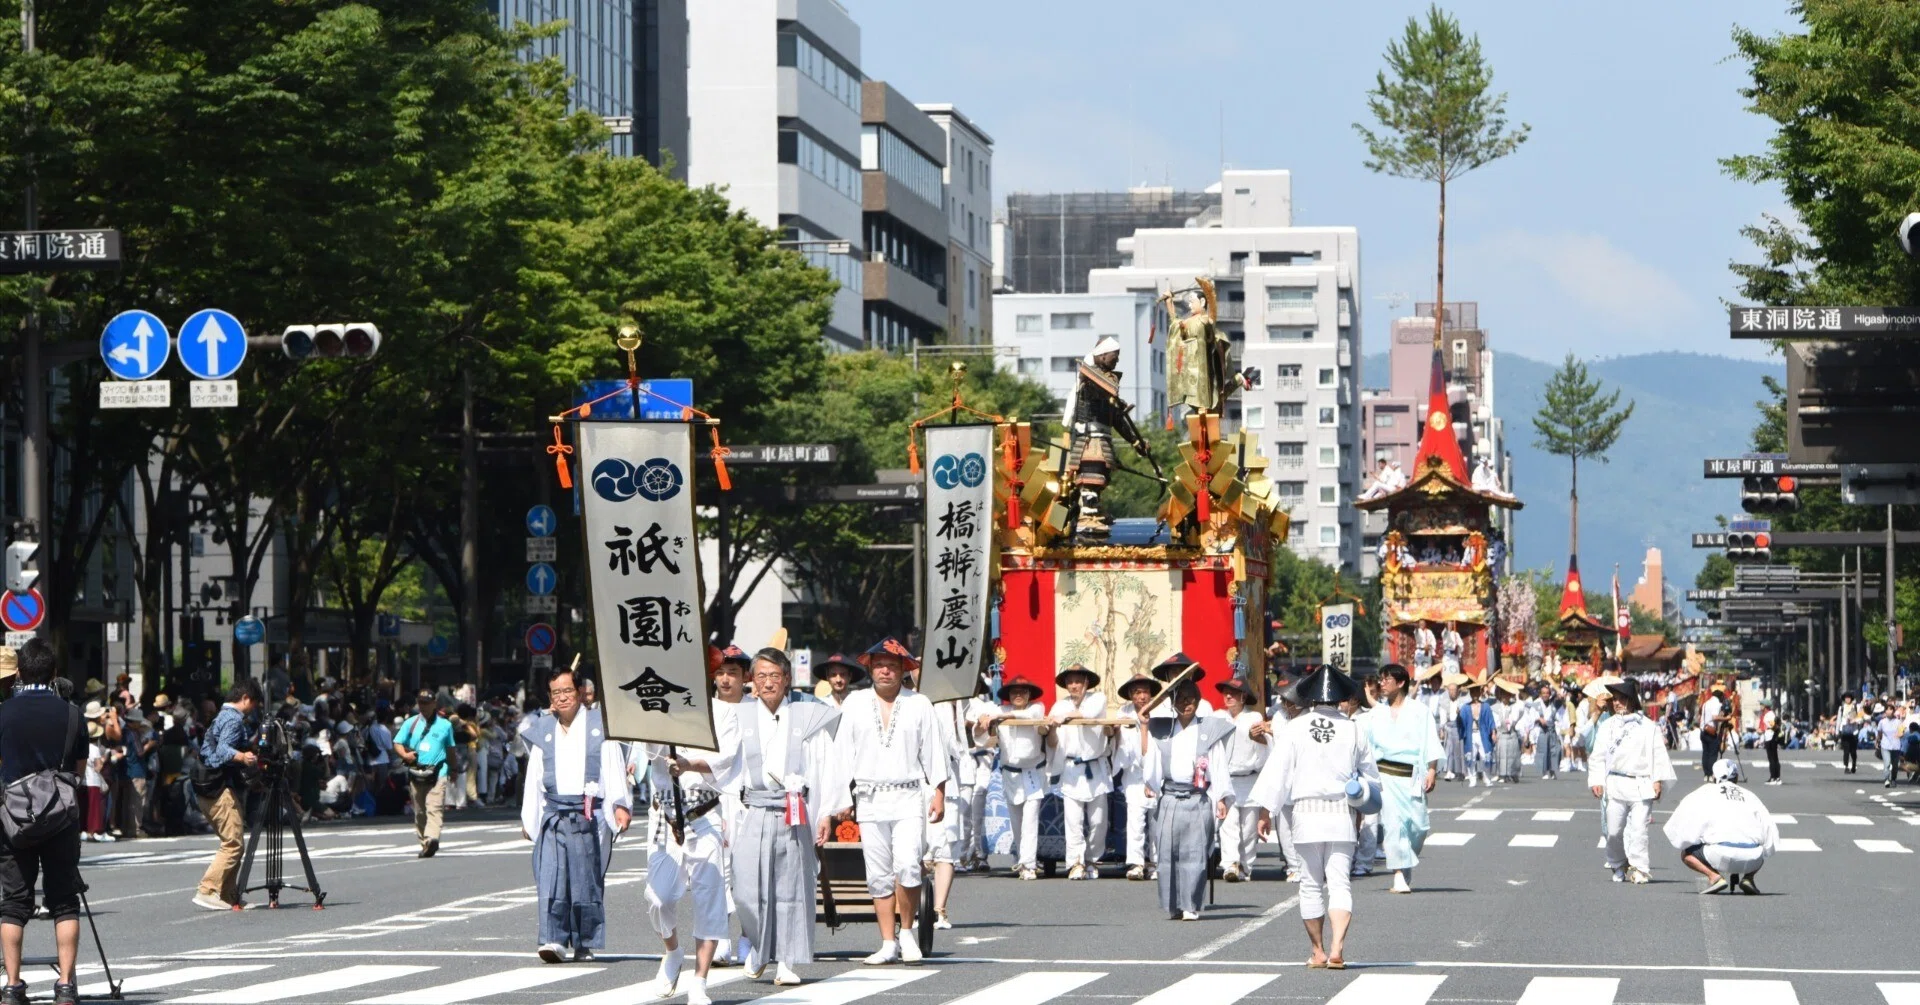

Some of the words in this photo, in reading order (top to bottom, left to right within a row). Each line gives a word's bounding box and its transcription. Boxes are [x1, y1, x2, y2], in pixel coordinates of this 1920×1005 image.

[1740, 308, 1842, 330] 東洞院通
[761, 446, 830, 462] 車屋町通
[1711, 460, 1775, 474] 車屋町通
